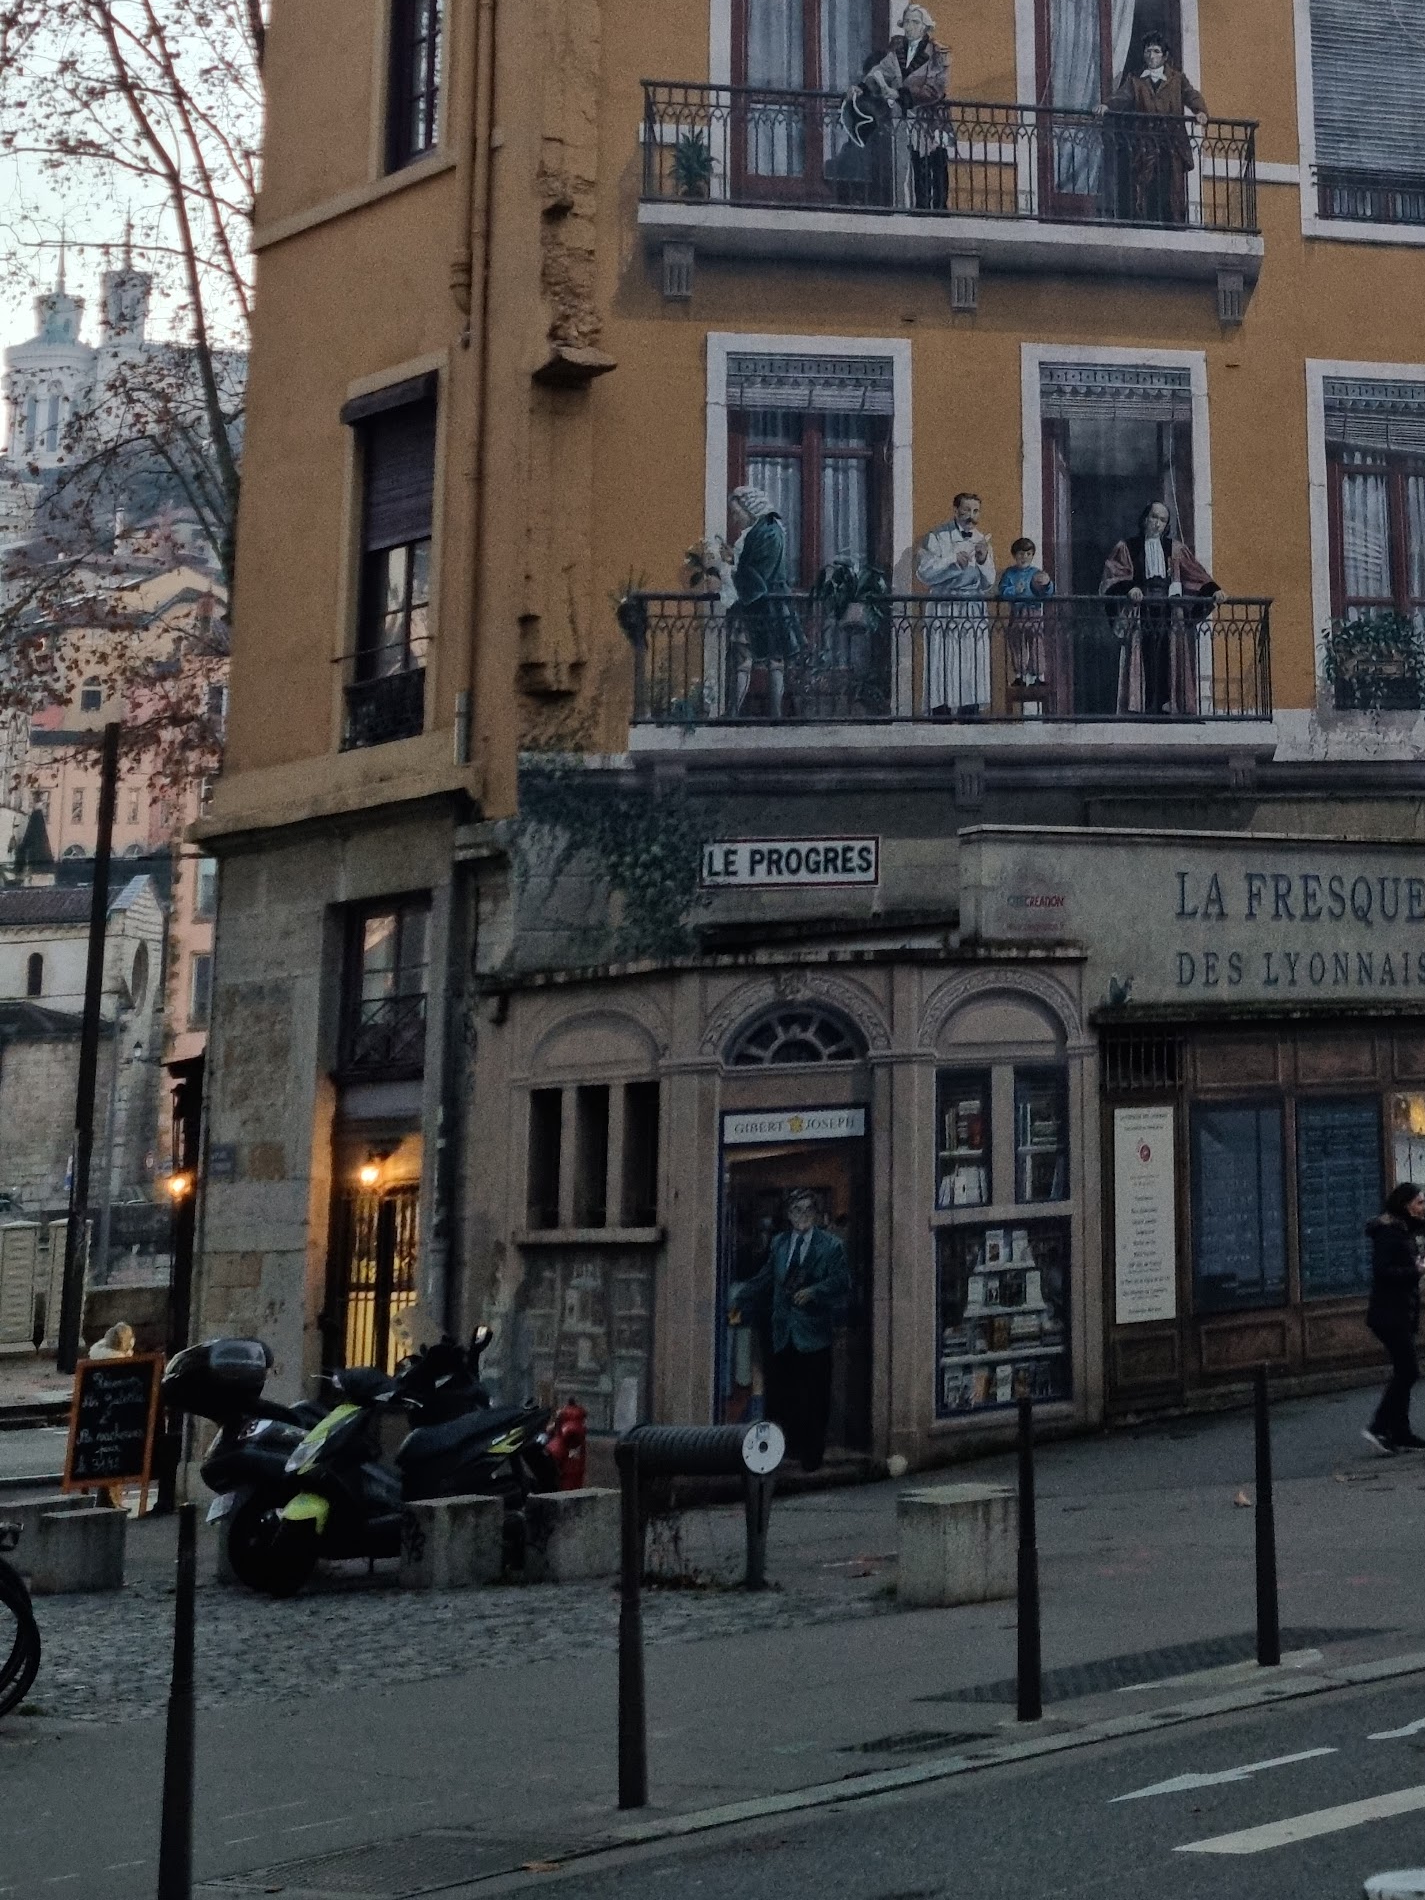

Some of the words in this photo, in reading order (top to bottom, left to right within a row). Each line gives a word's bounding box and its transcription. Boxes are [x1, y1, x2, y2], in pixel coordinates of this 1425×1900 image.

[706, 847, 739, 877] LE
[749, 844, 873, 877] PROGRES
[1175, 871, 1229, 921] LA
[1175, 951, 1243, 987] DES
[733, 1120, 785, 1135] GIBERT
[804, 1116, 856, 1131] JOSEPH
